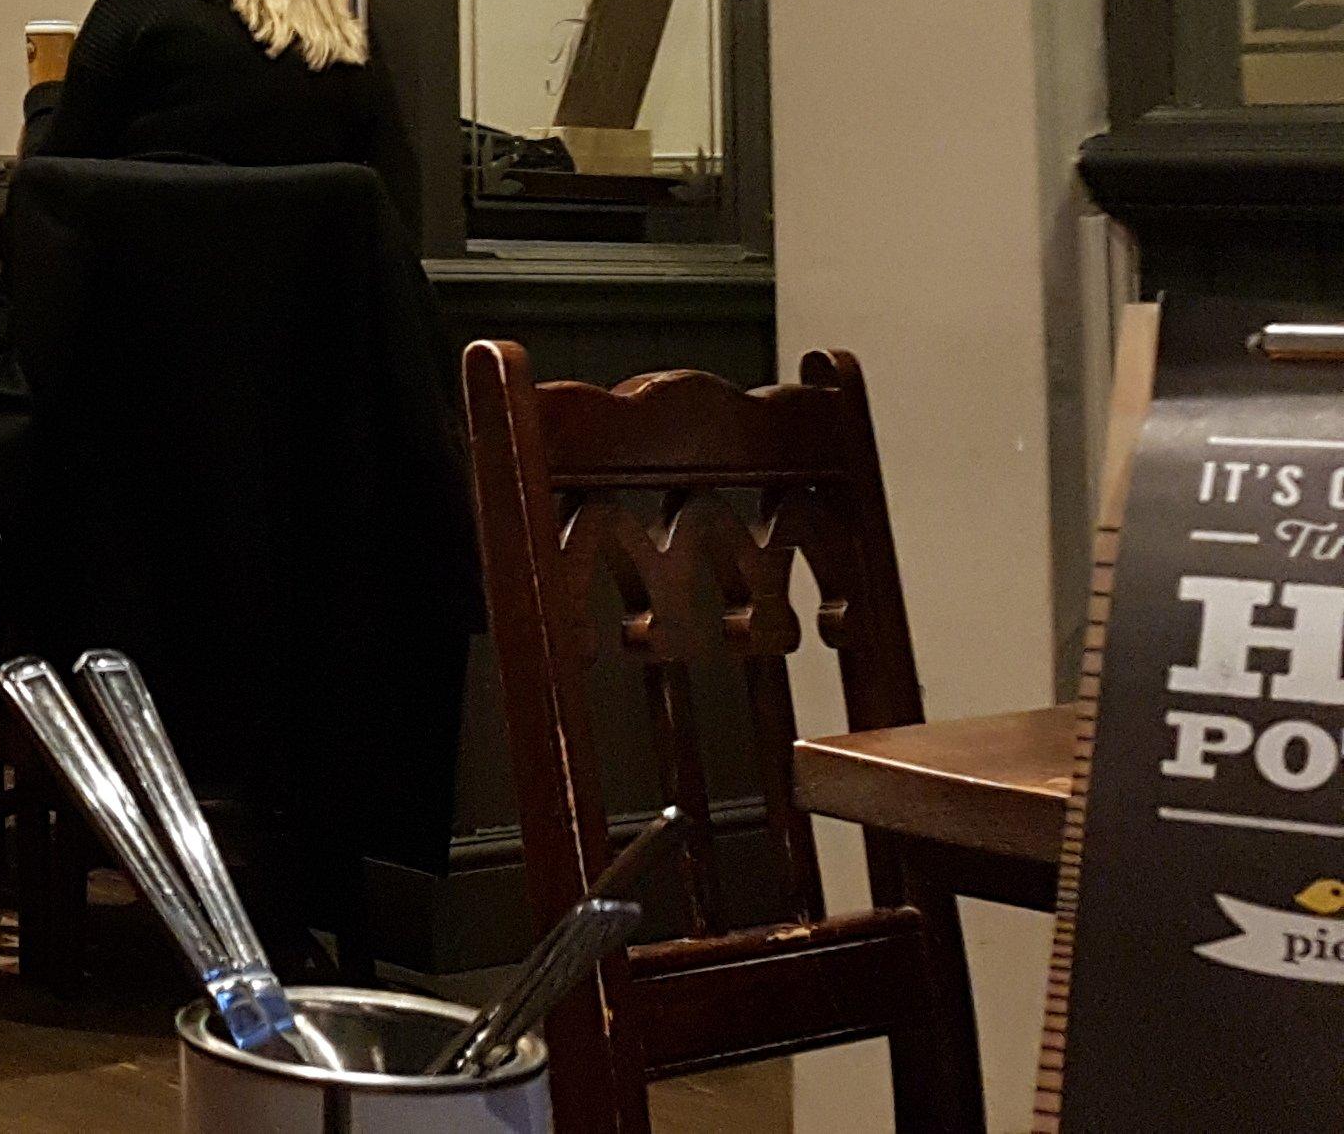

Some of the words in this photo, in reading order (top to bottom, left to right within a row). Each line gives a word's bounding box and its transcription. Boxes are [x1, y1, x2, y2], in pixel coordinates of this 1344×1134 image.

[1198, 461, 1304, 507] IT'S
[1275, 519, 1344, 560] Ti
[1160, 709, 1344, 792] PO
